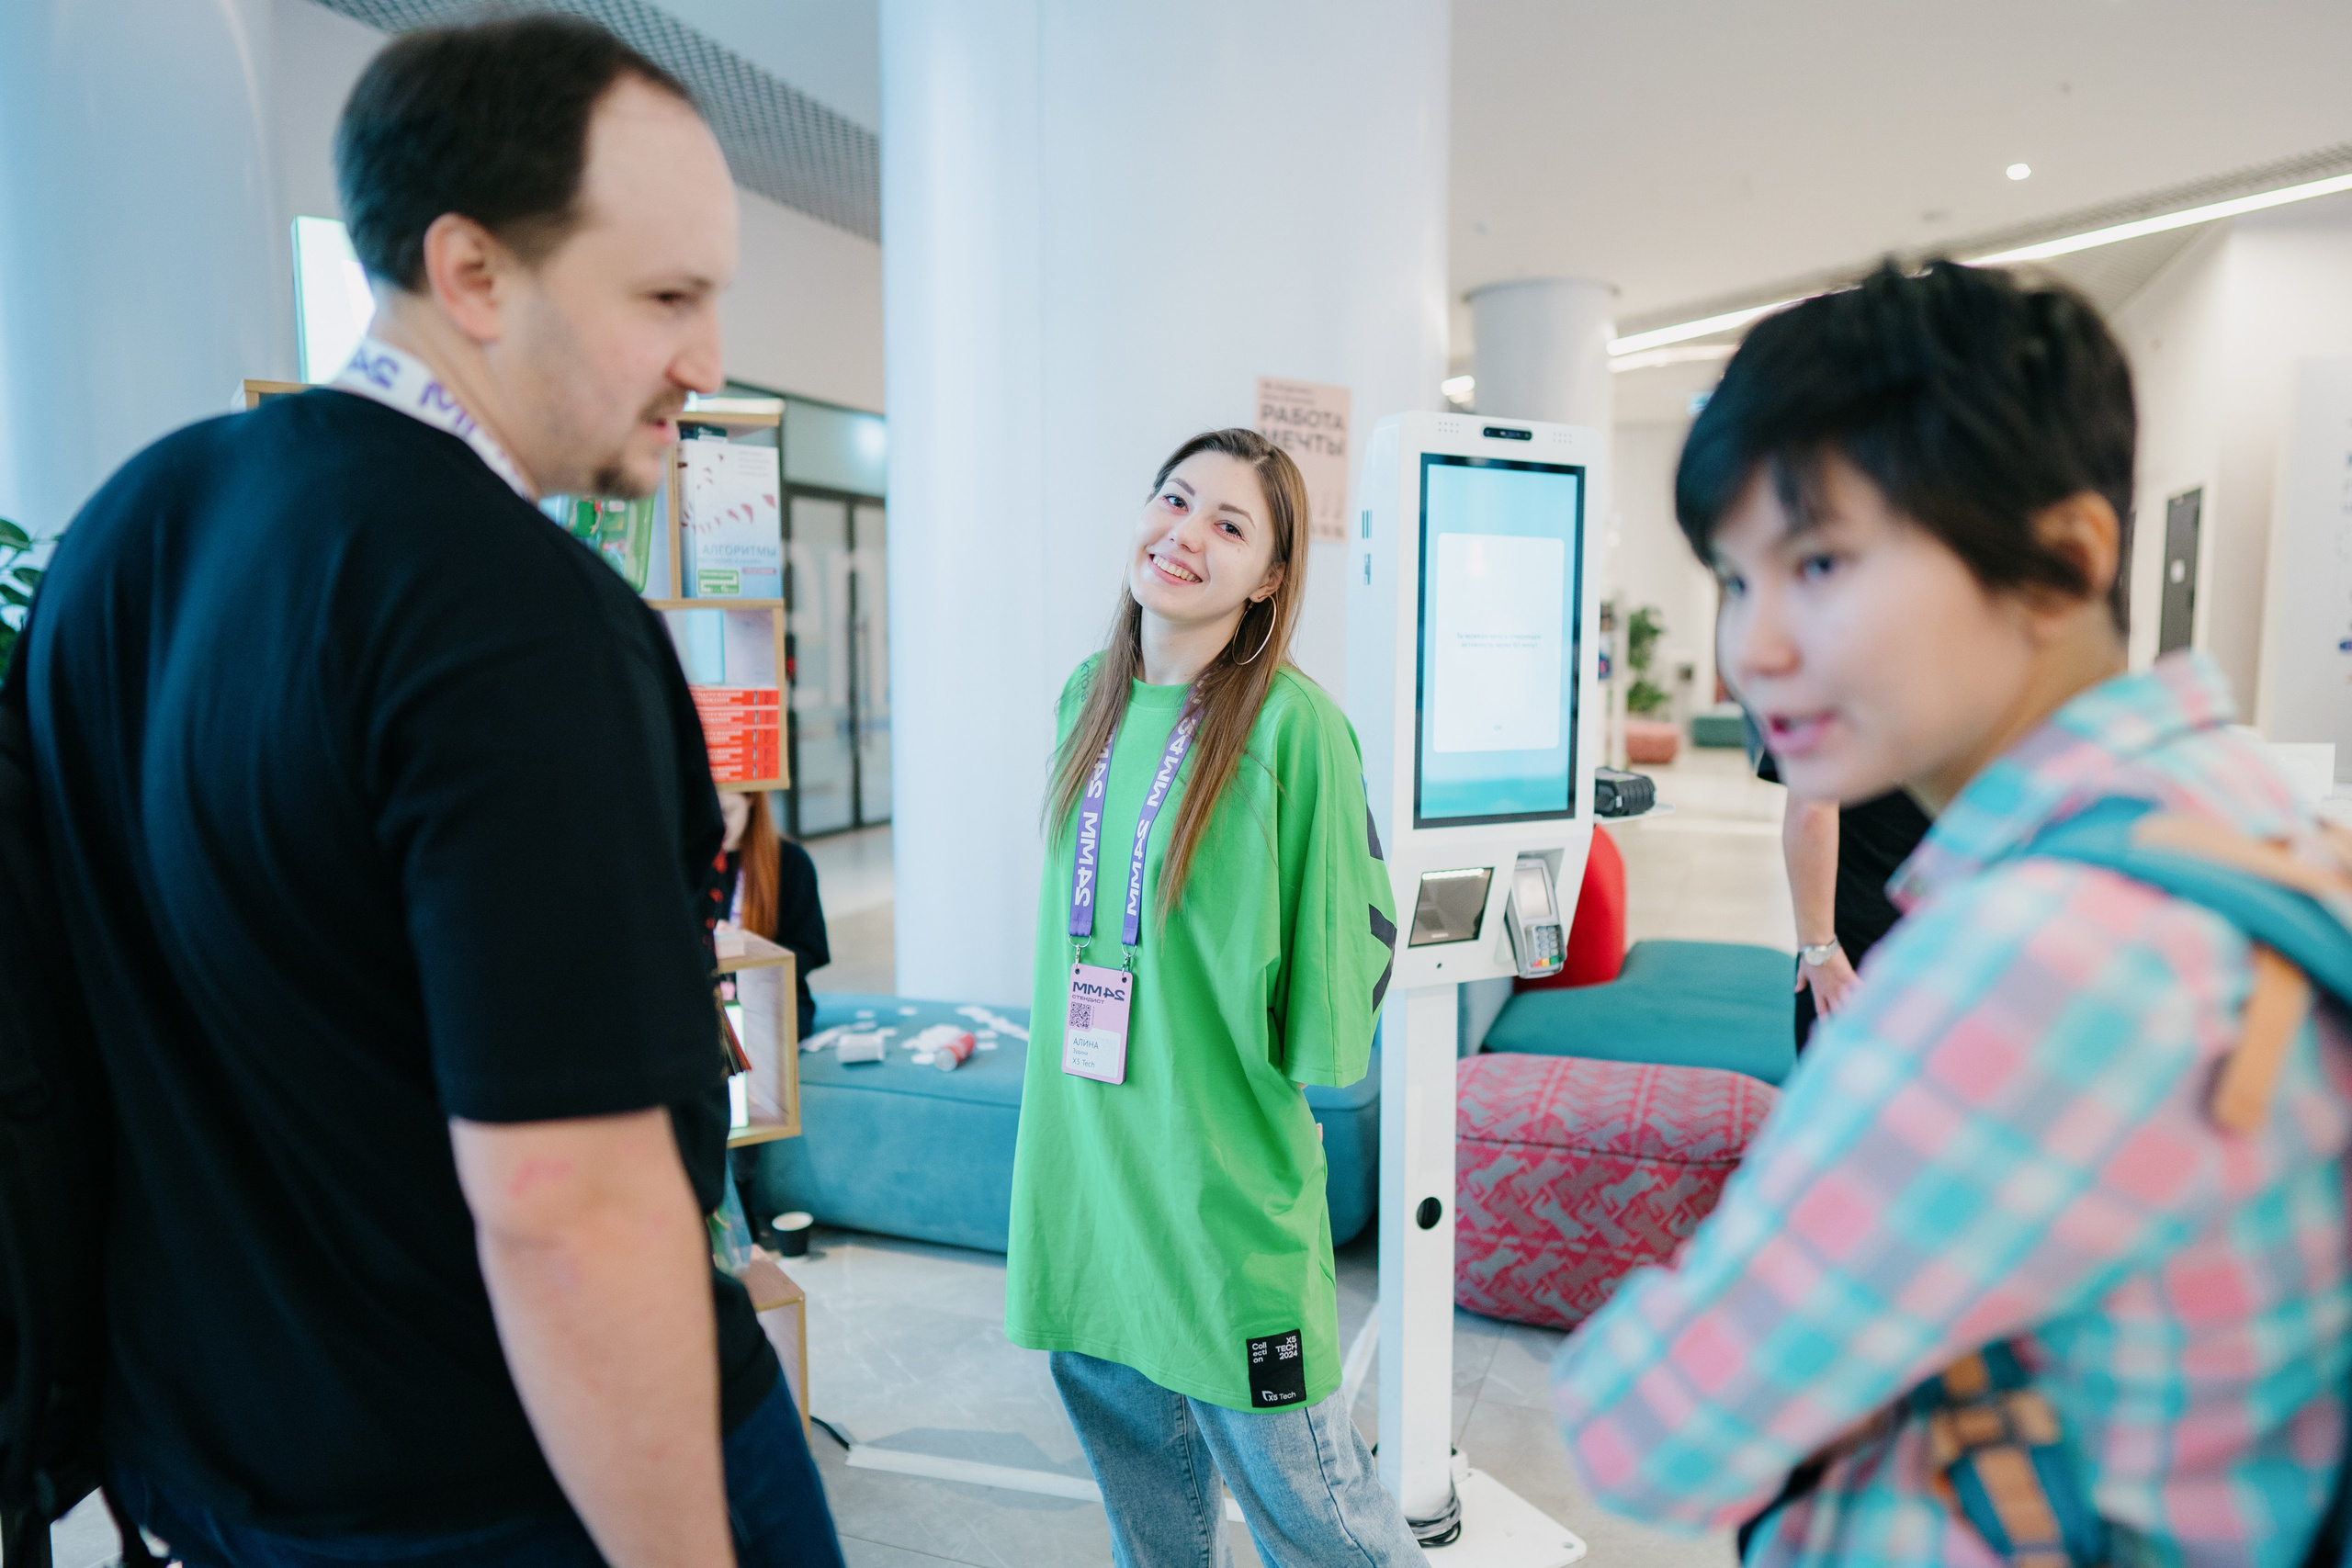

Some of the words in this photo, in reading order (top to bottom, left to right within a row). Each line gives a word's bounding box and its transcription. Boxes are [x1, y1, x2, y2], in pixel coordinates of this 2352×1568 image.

[1261, 404, 1345, 430] РАБОТА
[703, 545, 777, 558] АЛГОРИТМЫ
[1071, 994, 1105, 1004] СТЕНДИСТ
[1072, 1037, 1099, 1050] АЛИНА
[1072, 1057, 1080, 1066] X5
[1082, 1059, 1095, 1068] Tech
[1251, 1341, 1268, 1350] Coll
[1286, 1335, 1297, 1345] X5
[1252, 1348, 1268, 1357] ecti
[1275, 1342, 1298, 1353] TECH
[1279, 1349, 1298, 1360] 2024
[1268, 1393, 1278, 1402] X5
[1279, 1391, 1296, 1400] Tech
